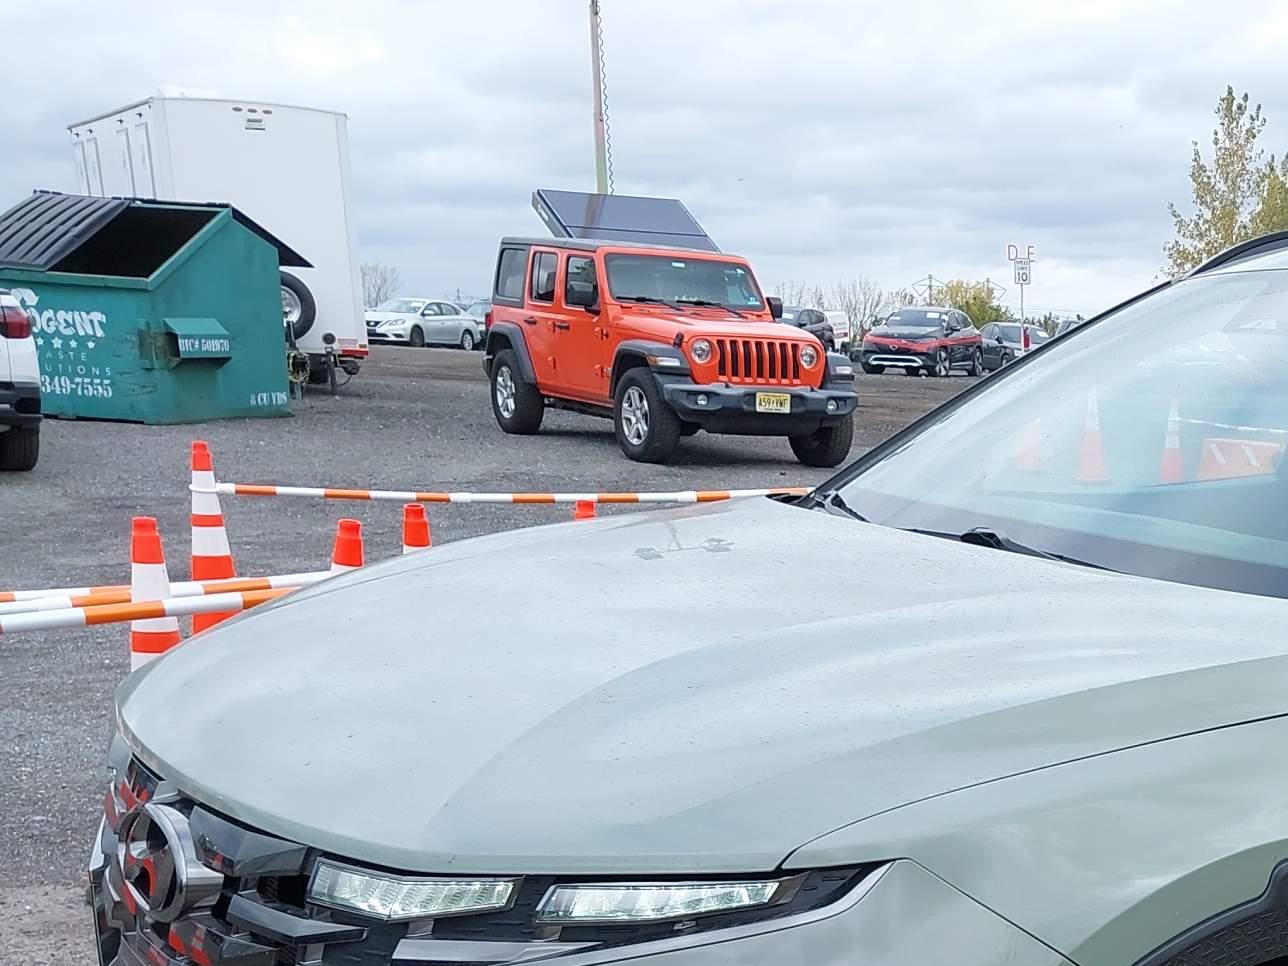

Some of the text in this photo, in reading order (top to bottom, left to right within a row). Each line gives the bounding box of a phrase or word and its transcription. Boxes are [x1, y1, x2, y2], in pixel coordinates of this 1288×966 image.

[1008, 244, 1018, 261] D
[1017, 272, 1028, 282] 10
[27, 308, 106, 337] OGENT
[38, 350, 87, 361] ASTE
[45, 363, 111, 376] UTIONS
[41, 375, 113, 398] 349-7555
[257, 392, 270, 406] CU
[271, 392, 288, 405] YDS
